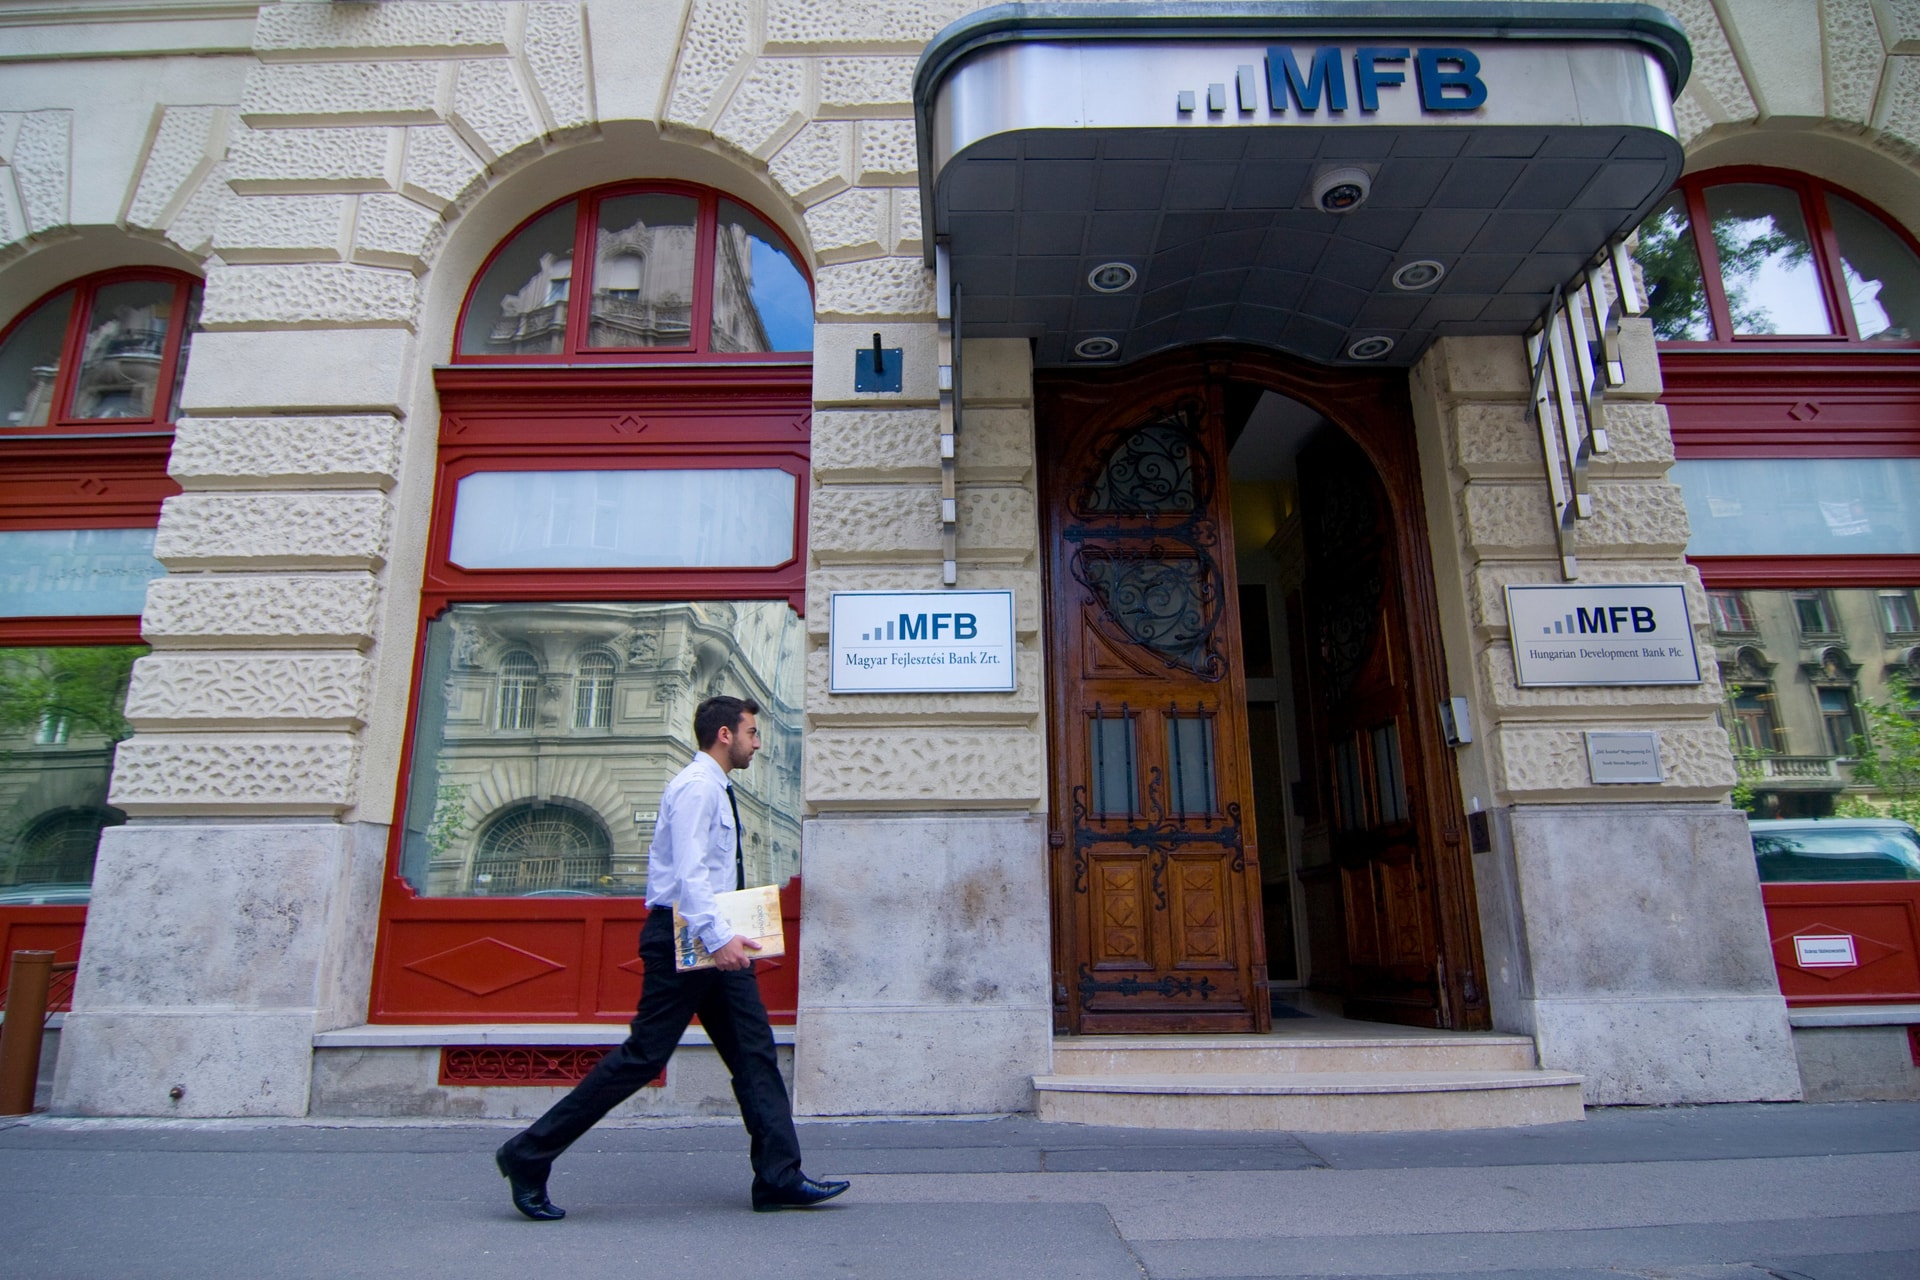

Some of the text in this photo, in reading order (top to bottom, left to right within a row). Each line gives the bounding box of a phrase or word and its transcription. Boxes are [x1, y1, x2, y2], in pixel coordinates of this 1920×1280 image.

[1265, 46, 1488, 111] MFB
[899, 613, 978, 641] MFB
[1576, 606, 1656, 634] MFB
[846, 651, 1001, 669] Magyar Fejlesztési Bank Zrt.
[1529, 647, 1684, 661] Hungarian Development Bank Plc.
